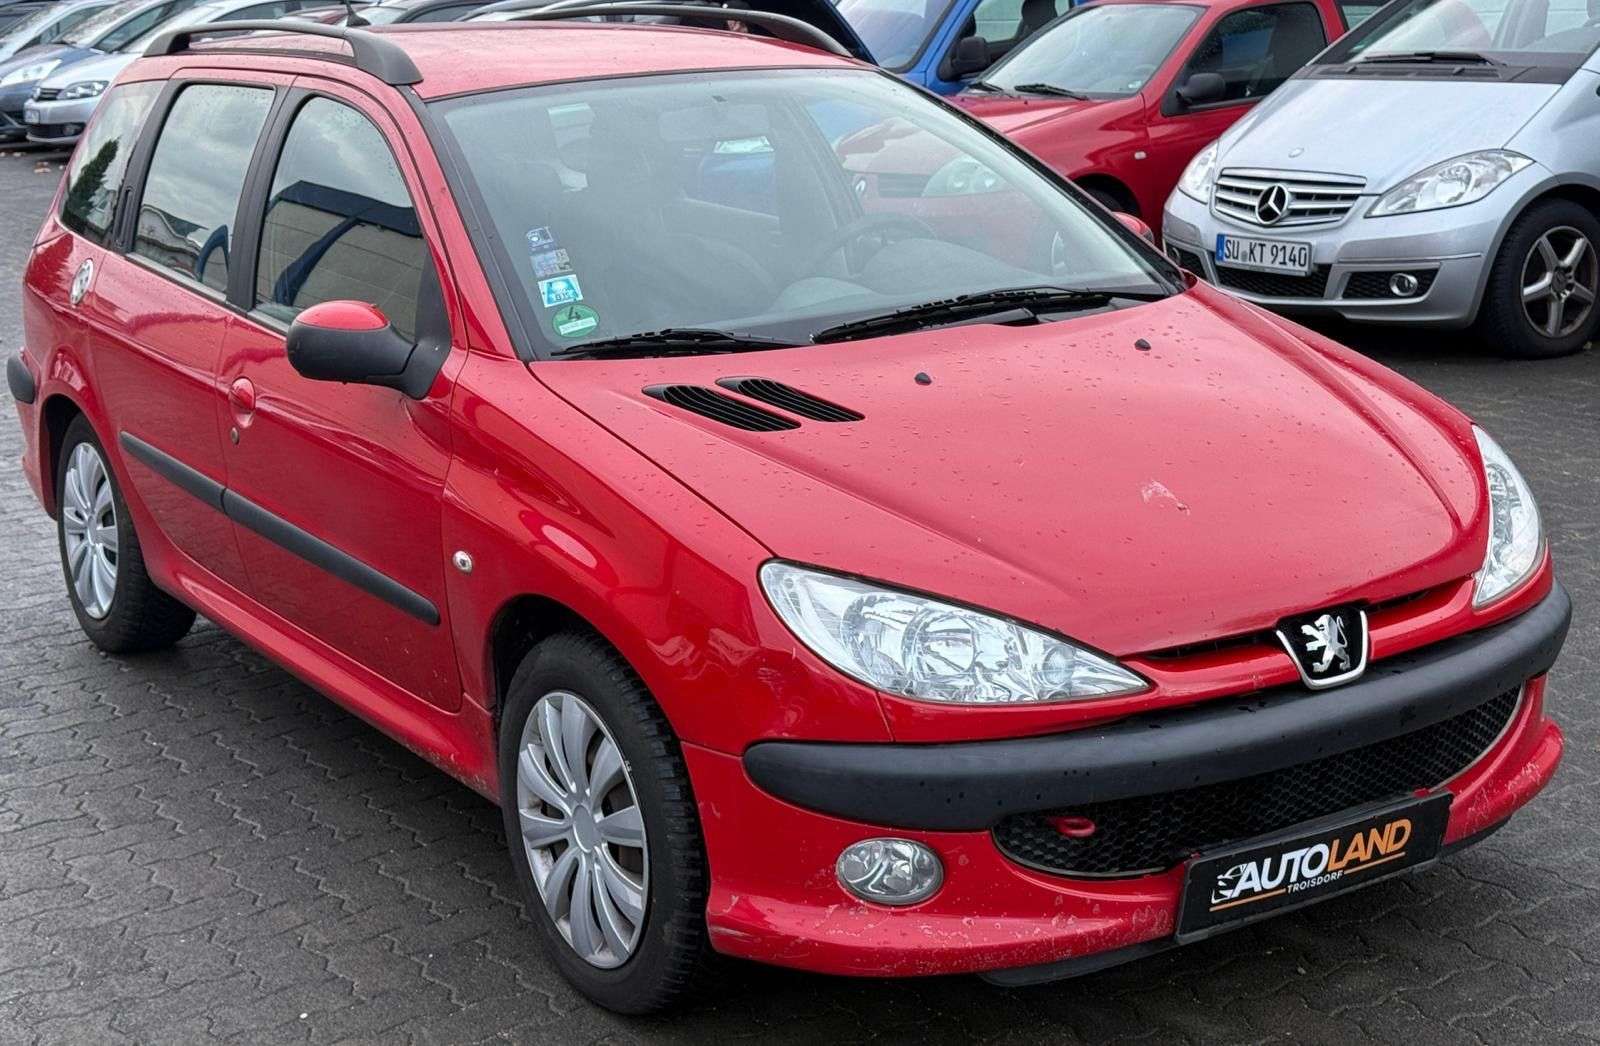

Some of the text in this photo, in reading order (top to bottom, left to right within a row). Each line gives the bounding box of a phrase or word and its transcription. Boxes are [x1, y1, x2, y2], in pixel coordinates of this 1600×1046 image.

[1224, 239, 1307, 267] SU KT 9140
[568, 306, 581, 320] 4
[1231, 818, 1412, 899] AUTOLAND
[1287, 869, 1344, 894] TROISDORF
